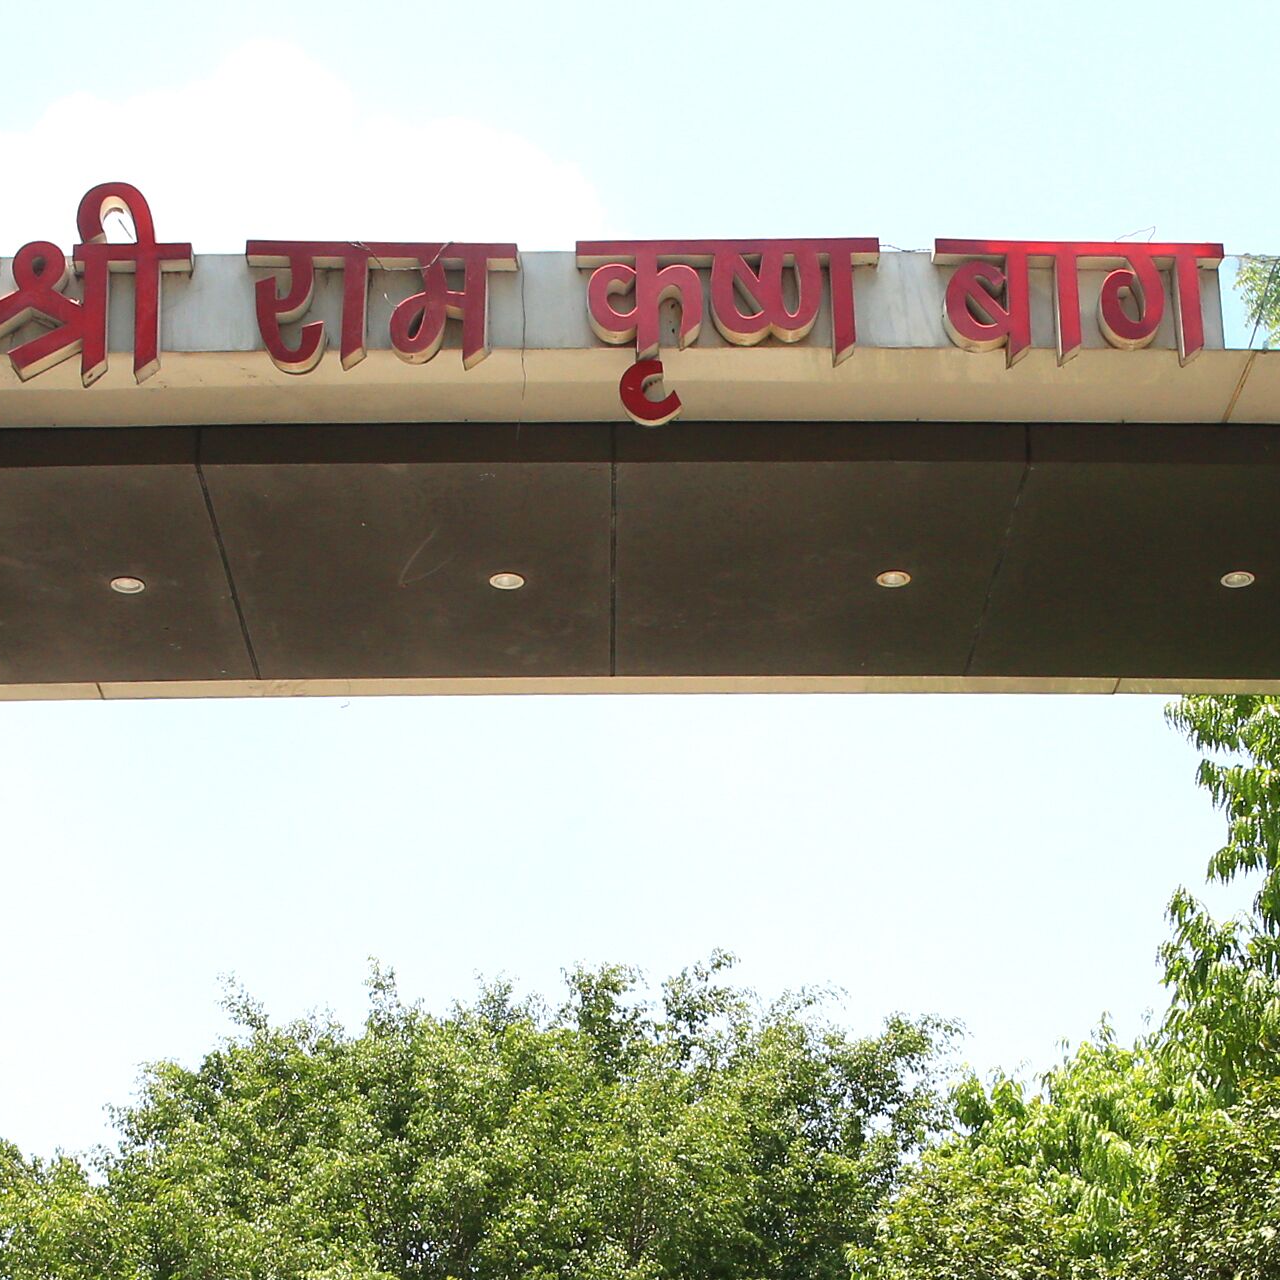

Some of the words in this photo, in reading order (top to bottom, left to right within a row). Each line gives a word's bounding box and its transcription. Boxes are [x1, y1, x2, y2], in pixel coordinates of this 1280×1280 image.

[247, 241, 518, 372] राम
[576, 239, 879, 426] कृष्ण
[934, 241, 1224, 366] बाग
